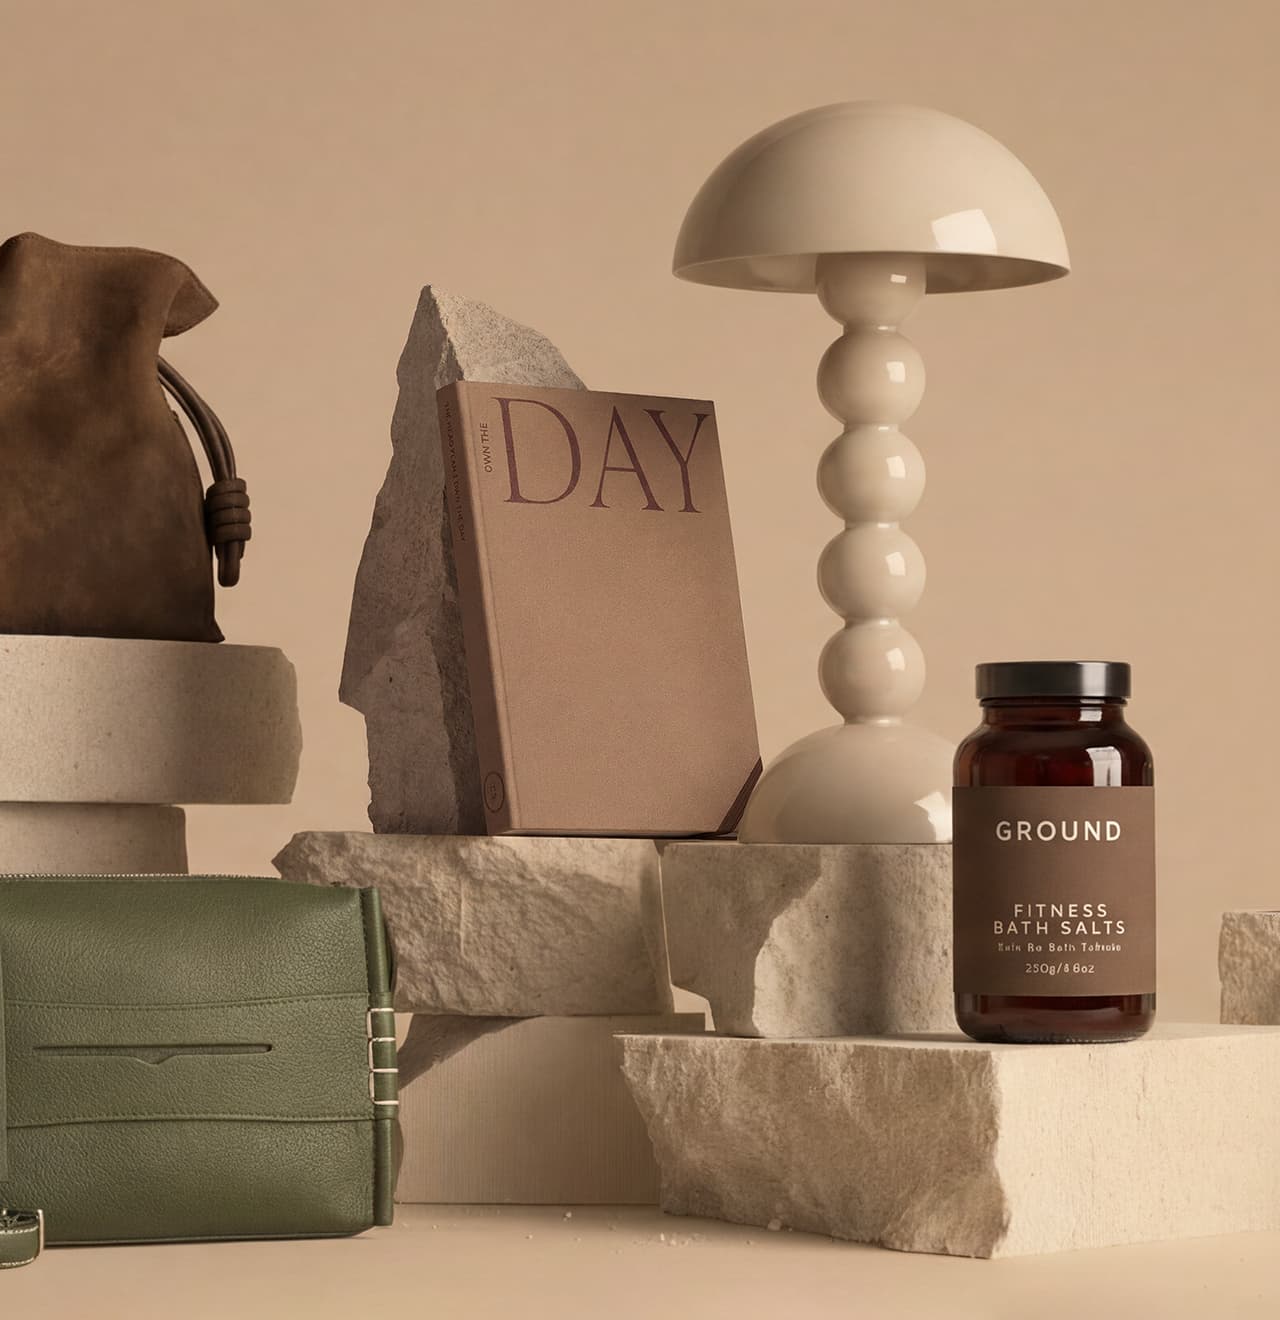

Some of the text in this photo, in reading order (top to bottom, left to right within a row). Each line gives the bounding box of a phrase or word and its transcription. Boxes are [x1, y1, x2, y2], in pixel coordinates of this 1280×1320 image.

[479, 422, 493, 473] OWN THE
[491, 396, 711, 514] DAY
[996, 820, 1122, 842] GROUND
[1014, 903, 1108, 918] FITNESS
[993, 920, 1126, 935] BATH SALTS
